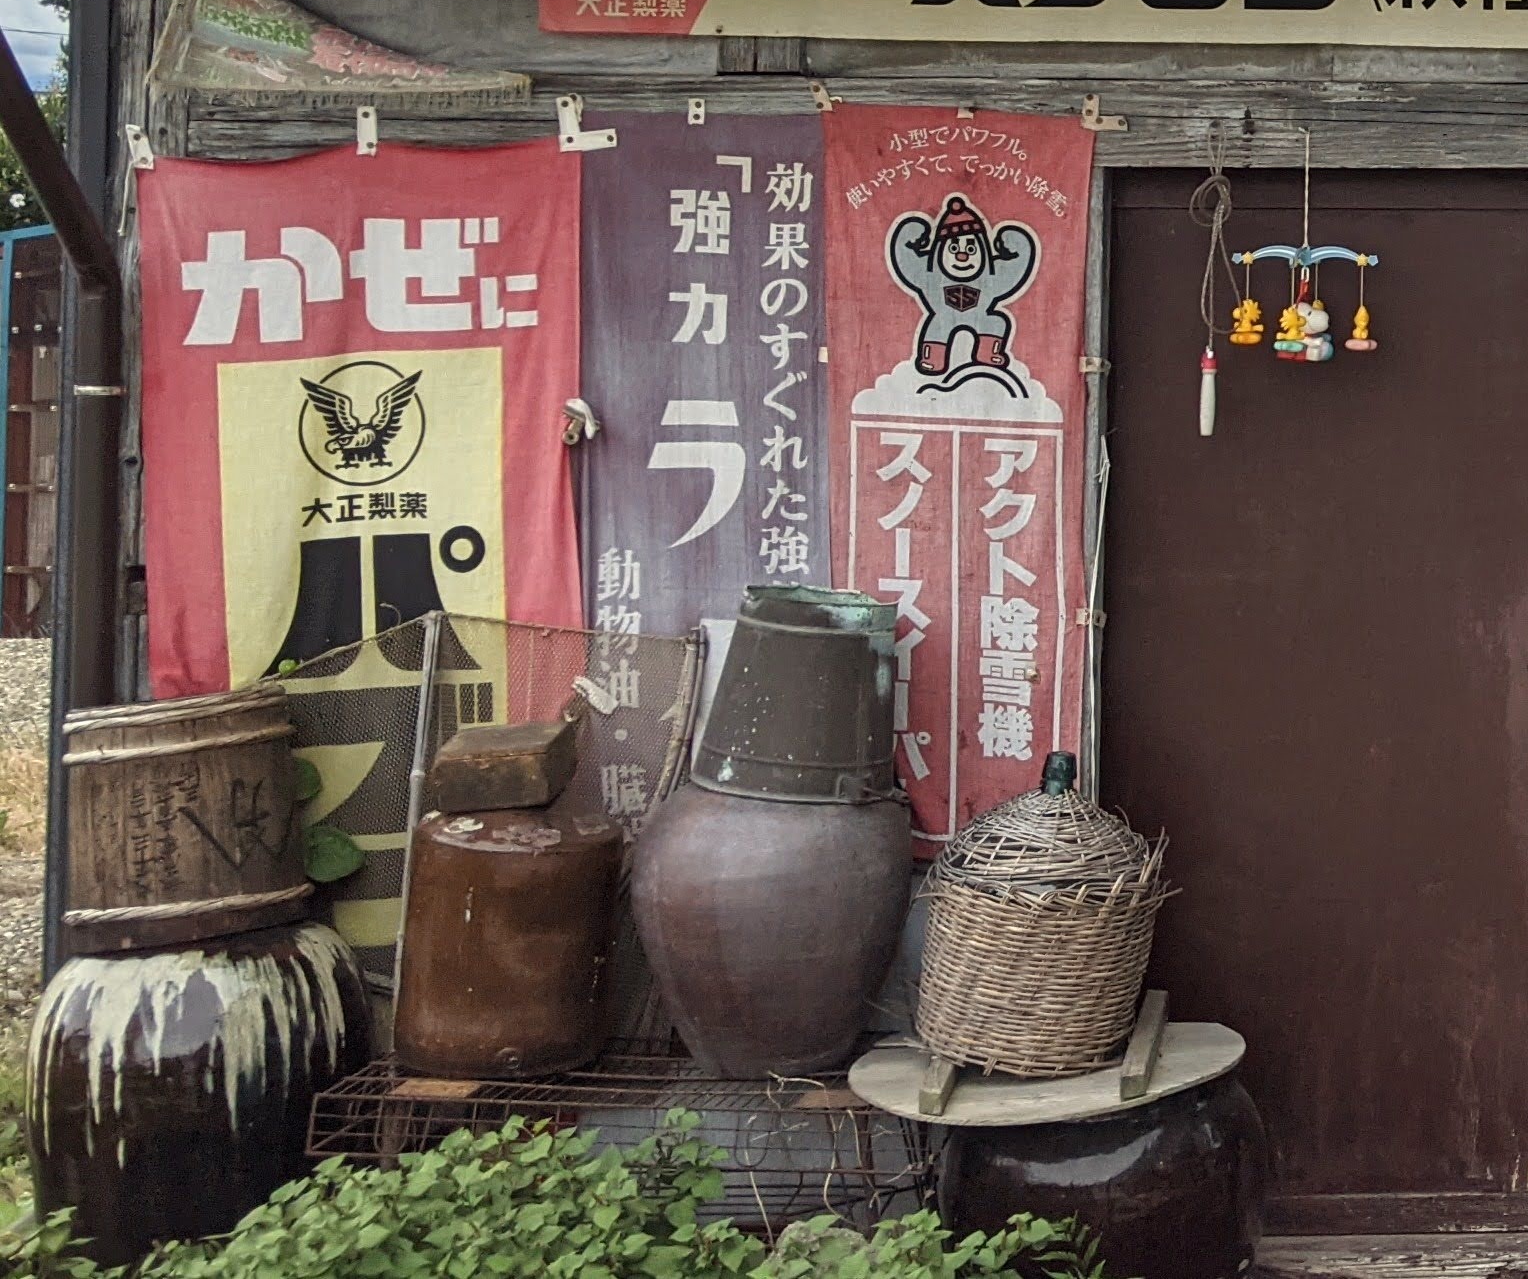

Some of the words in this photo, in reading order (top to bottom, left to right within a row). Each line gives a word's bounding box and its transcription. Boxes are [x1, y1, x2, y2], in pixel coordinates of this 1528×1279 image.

[889, 125, 1028, 162] 小型でパワフル。
[181, 216, 539, 346] かぜに
[758, 161, 814, 585] 効果のすぐれた強
[301, 491, 429, 527] 大正製薬
[976, 437, 1040, 761] アクト除雪機
